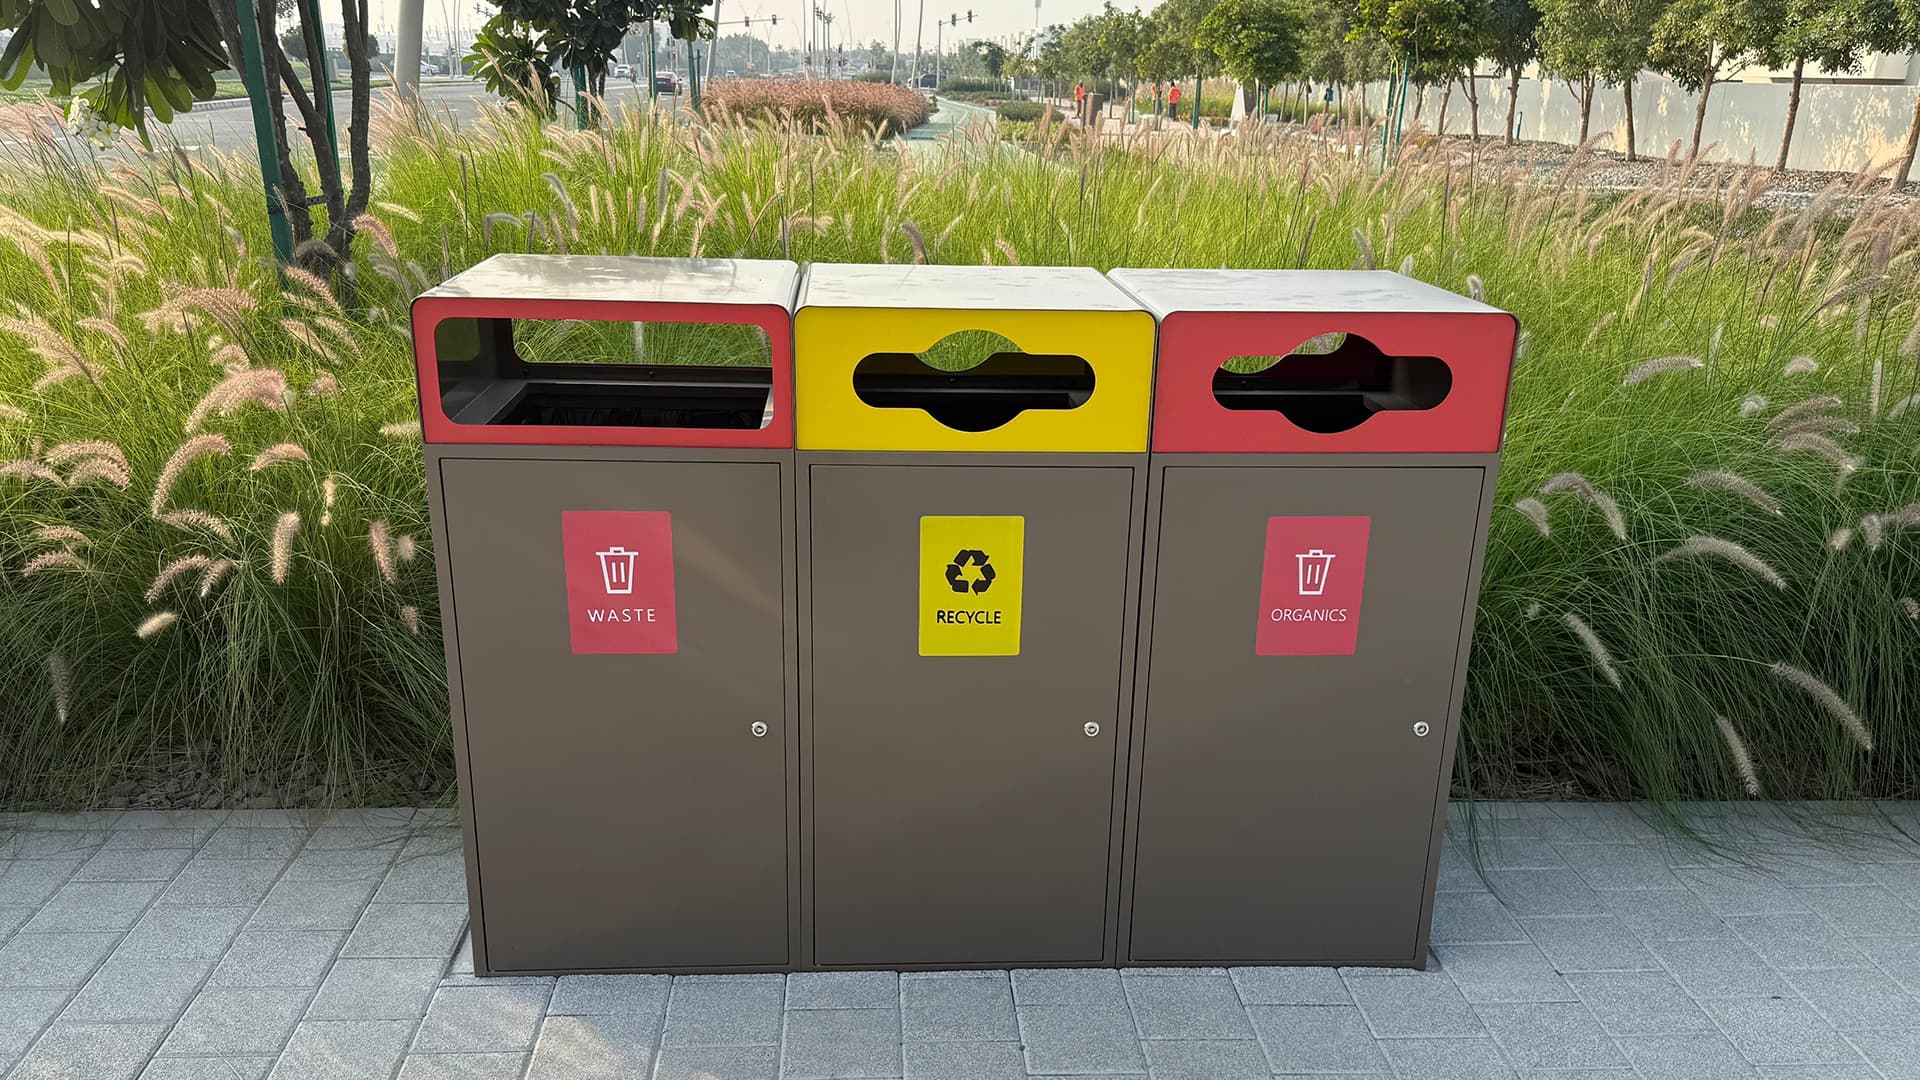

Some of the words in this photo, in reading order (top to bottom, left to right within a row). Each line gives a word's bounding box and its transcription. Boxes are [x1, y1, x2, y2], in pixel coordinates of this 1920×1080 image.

[587, 608, 657, 623] WASTE
[936, 610, 1002, 625] RECYCLE
[1270, 608, 1348, 623] ORGANICS
